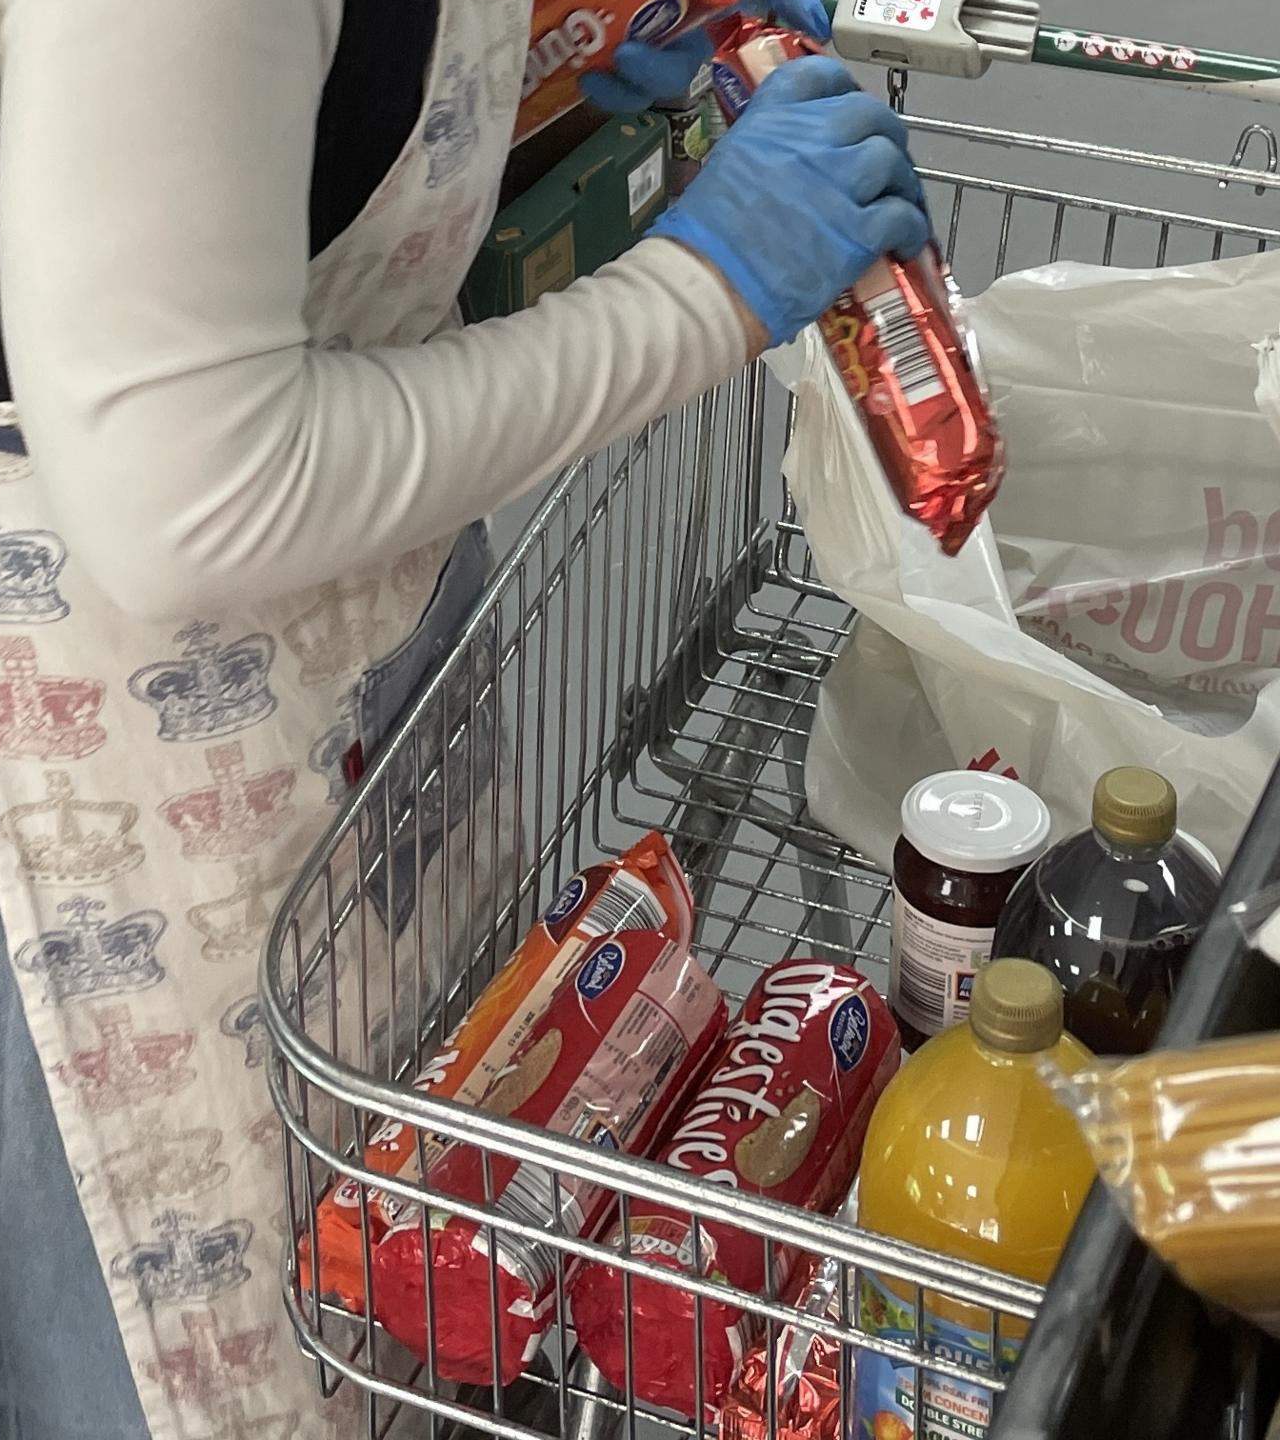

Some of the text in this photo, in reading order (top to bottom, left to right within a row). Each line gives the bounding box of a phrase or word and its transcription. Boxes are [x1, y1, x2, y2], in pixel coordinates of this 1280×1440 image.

[901, 1394, 950, 1425] DOBLE
[951, 1417, 985, 1439] STRE
[933, 1394, 989, 1424] CONCEN
